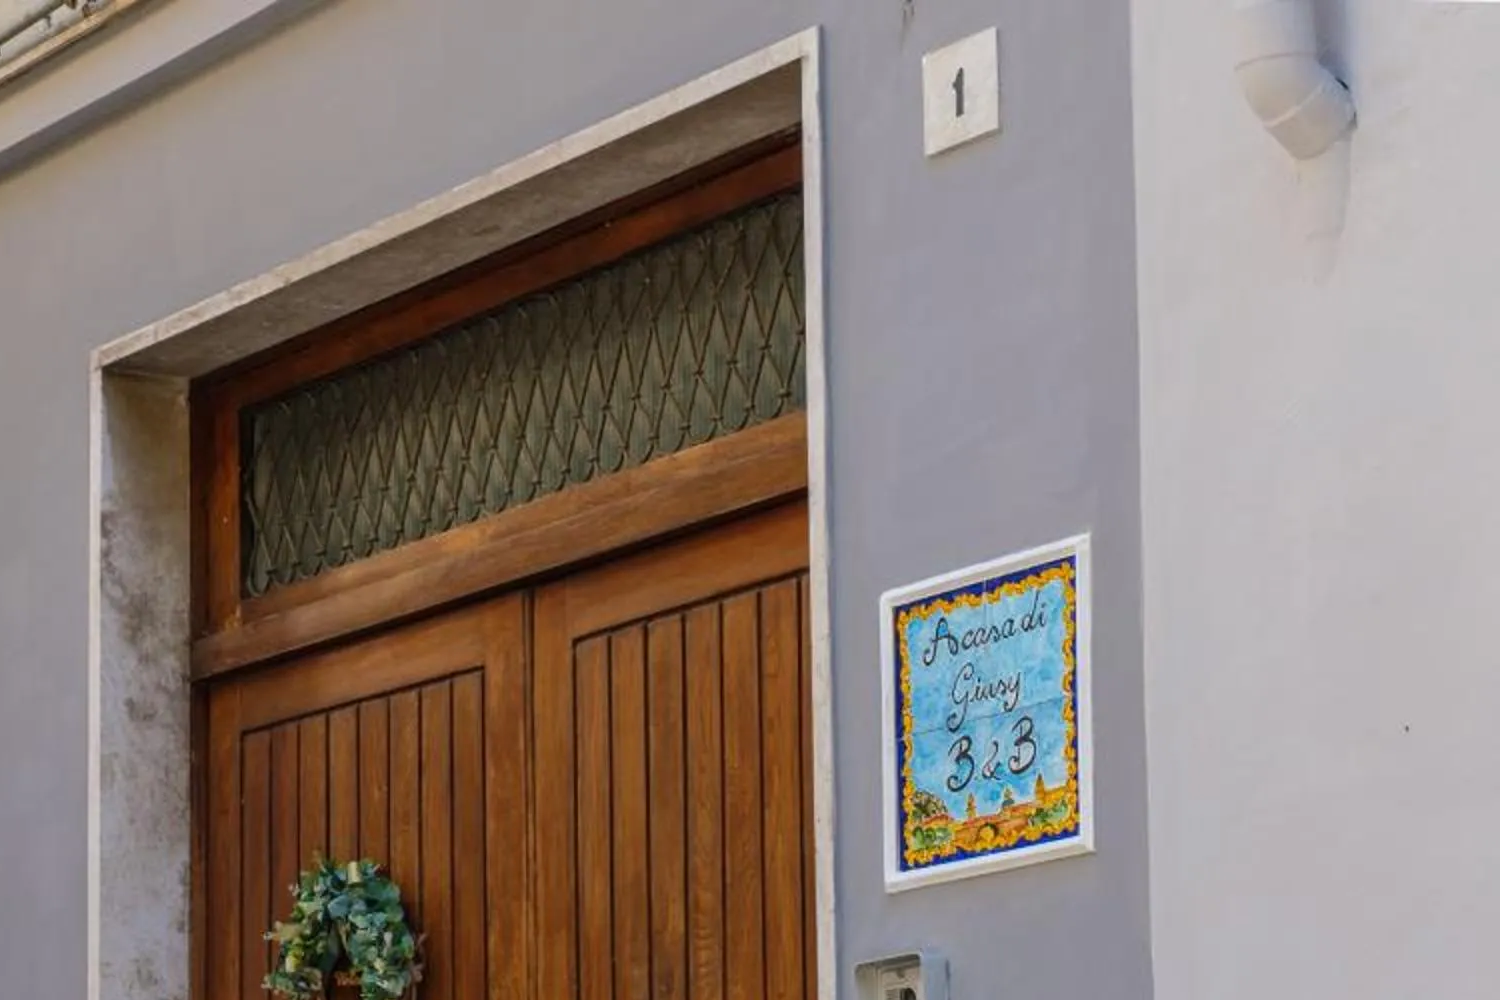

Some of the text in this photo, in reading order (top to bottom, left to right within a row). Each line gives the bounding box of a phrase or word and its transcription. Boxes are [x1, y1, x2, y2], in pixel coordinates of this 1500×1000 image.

[952, 66, 965, 118] 1
[923, 590, 1047, 666] A casa di
[946, 661, 1021, 733] Giusy
